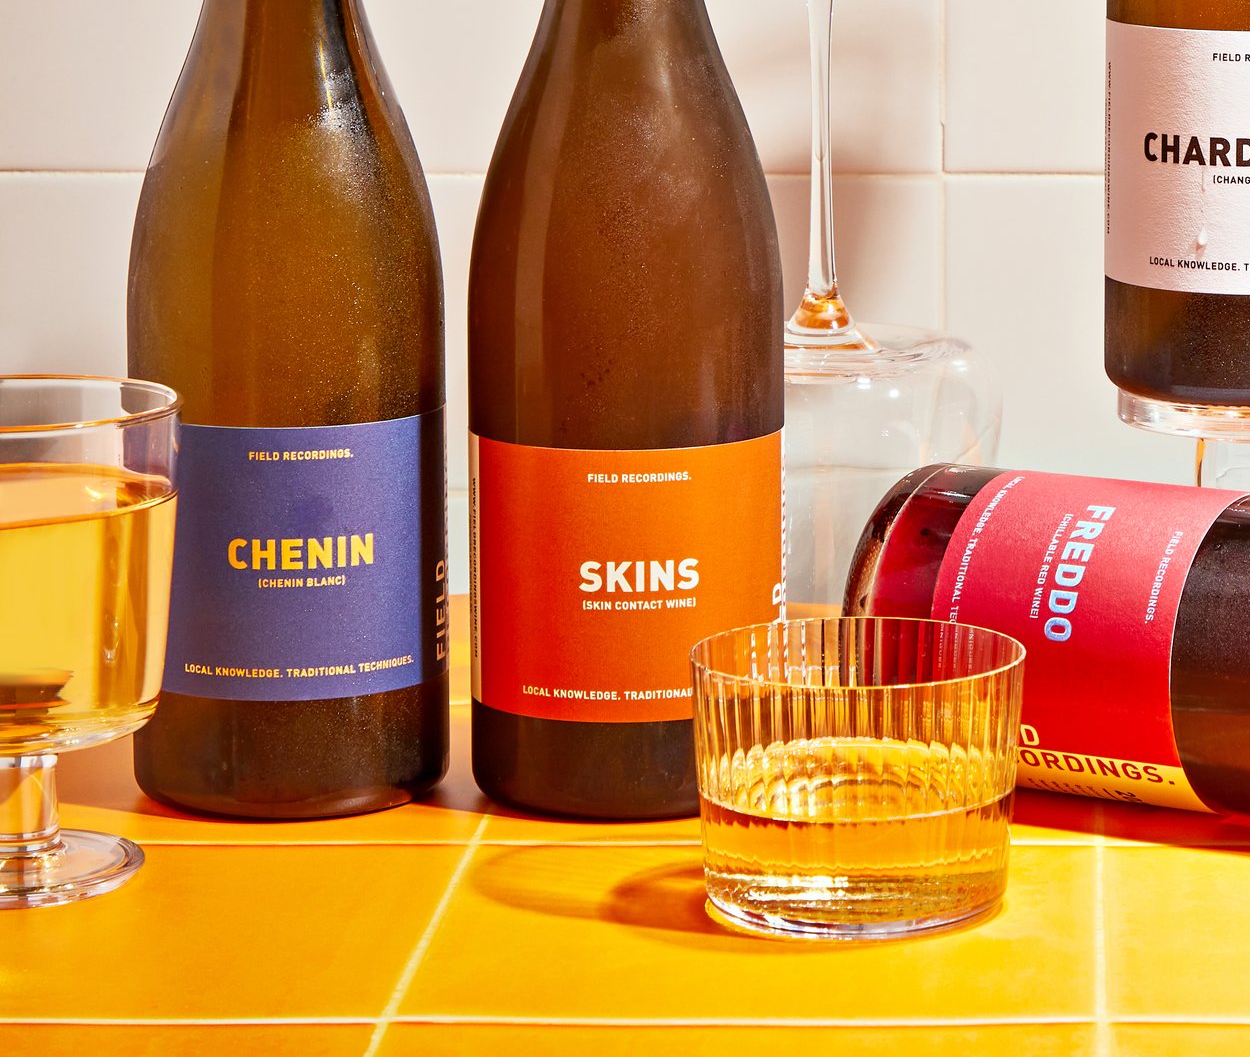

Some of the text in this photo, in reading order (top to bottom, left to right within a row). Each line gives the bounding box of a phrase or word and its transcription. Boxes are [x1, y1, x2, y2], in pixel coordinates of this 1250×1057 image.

[1212, 53, 1241, 62] FIELD
[1149, 256, 1175, 267] LOCAL
[1177, 260, 1240, 271] KNOWLEDGE.
[248, 448, 354, 461] FIELD RECORDINGS.
[587, 471, 692, 483] FIELD RECORDINGS.
[972, 489, 1008, 536] KNOWLEDGE.
[227, 533, 374, 570] CHENIN
[1030, 513, 1074, 619] (CHILLABLE RED WINE)
[258, 574, 346, 589] (CHENIN BLANC)
[578, 558, 700, 593] SKINS
[951, 538, 978, 603] TRADITIONAL
[1044, 504, 1116, 642] FREDDO
[1144, 530, 1183, 625] FIELD RECORDINGS.
[436, 559, 446, 661] FIELD
[582, 597, 697, 610] (SKIN CONTACT WINE)
[184, 655, 414, 678] LOCAL KNOWLEDGE. TRADITIONAL TECHNIQUES.
[522, 685, 693, 700] LOCAL KNOWLEDGE. TRADITIONAL
[1017, 749, 1175, 785] ORDINGS.
